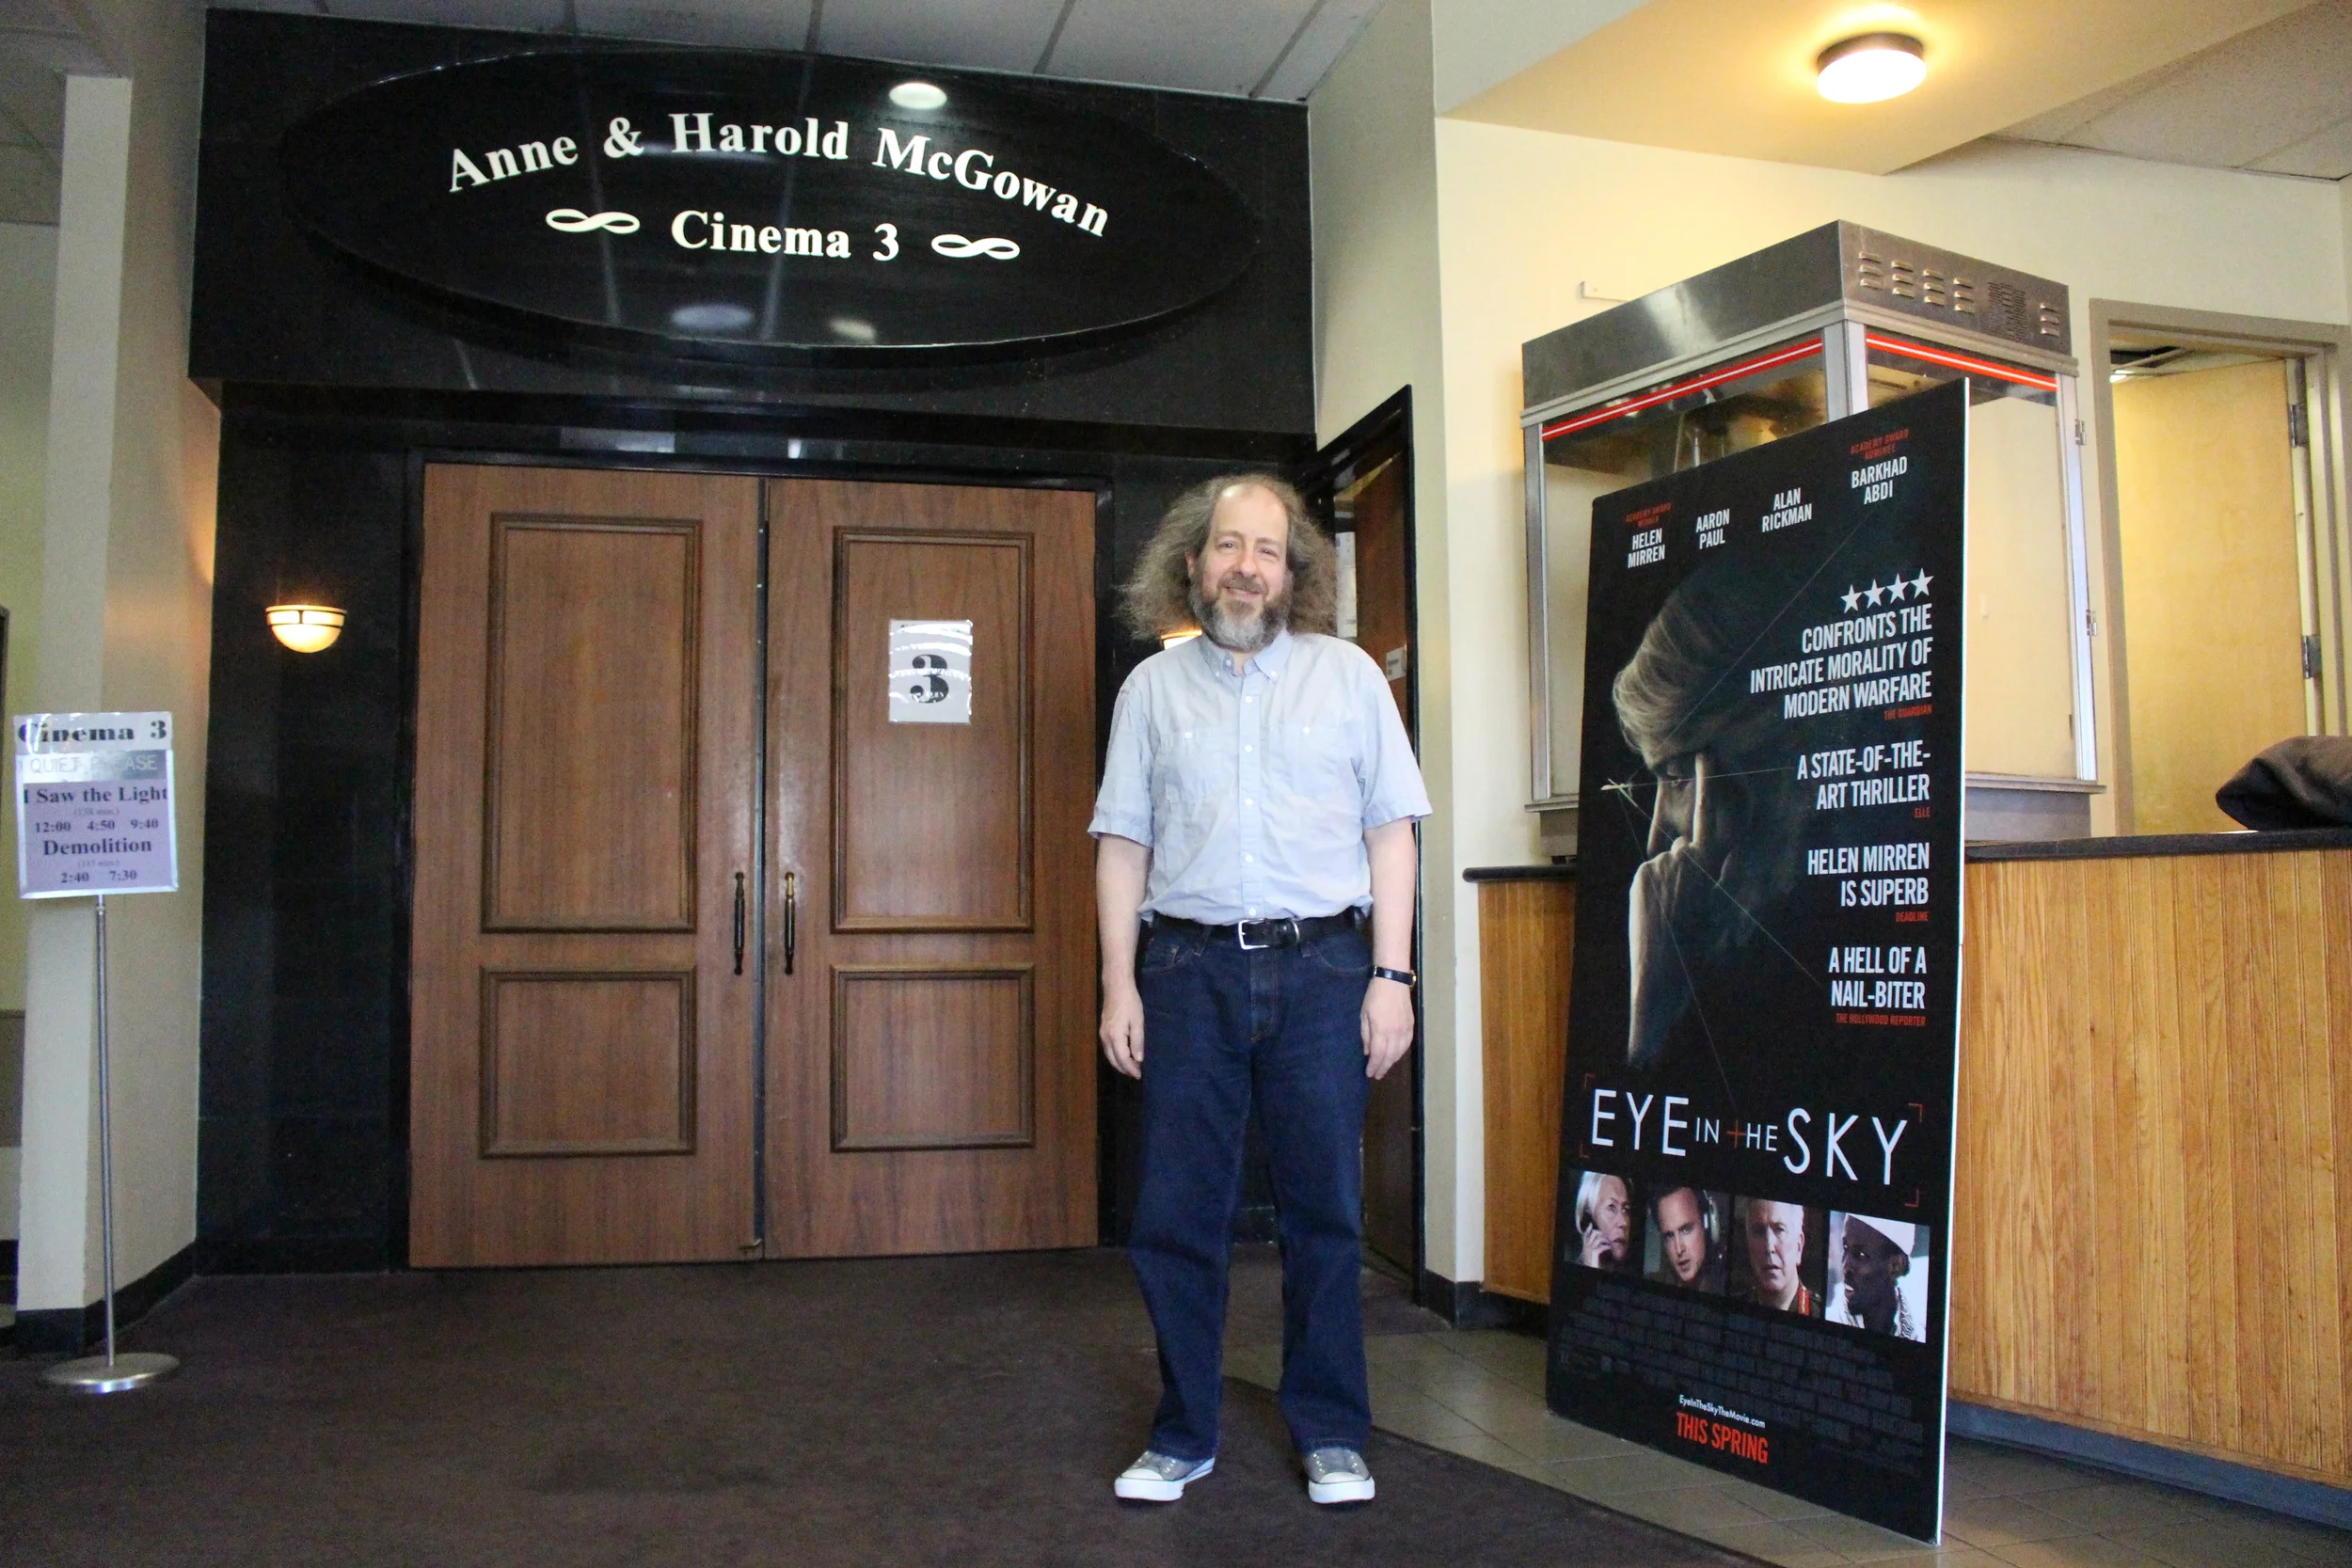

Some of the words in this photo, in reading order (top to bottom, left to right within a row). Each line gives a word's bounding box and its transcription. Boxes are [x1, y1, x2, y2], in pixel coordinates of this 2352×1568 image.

[449, 134, 580, 194] Anne
[602, 117, 645, 159] &
[668, 112, 850, 160] Harold
[875, 128, 1110, 237] McGowan
[672, 209, 851, 259] Cinema
[872, 224, 900, 261] 3
[1851, 455, 1908, 489] BARKHAD
[1772, 487, 1802, 511] ALAN
[1864, 480, 1894, 505] ABDI
[1695, 508, 1730, 533] AARON
[1761, 503, 1813, 532] RICKMAN
[1631, 528, 1662, 551] HELEN
[1699, 529, 1725, 549] PAUL
[1628, 545, 1665, 568] MIRREN
[1802, 610, 1897, 654] CONFRONTS
[1899, 603, 1932, 634] THE
[910, 654, 949, 704] 3
[1750, 657, 1823, 694] INTRICATE
[1827, 641, 1908, 681] MORALITY
[1911, 637, 1933, 666] OF
[1784, 685, 1851, 720] MODERN
[1853, 671, 1932, 708] WARFARE
[18, 722, 135, 742] Cinema
[150, 720, 167, 739] 3
[90, 753, 158, 772] PASE
[1797, 754, 1808, 780] A
[1810, 739, 1931, 779] STATE-OF-THE-
[37, 788, 74, 804] Saw
[83, 787, 112, 802] the
[119, 786, 168, 804] Light
[1816, 783, 1848, 810] ART
[1851, 773, 1931, 806] THRILLER
[35, 820, 72, 833] 12:00
[87, 819, 115, 832] 4:50
[130, 817, 159, 830] 9:40
[43, 837, 152, 856] Demolition
[1807, 847, 1859, 876] HELEN
[1863, 842, 1930, 873] MIRREN
[61, 871, 89, 883] 2:40
[109, 869, 137, 881] 7:30
[1840, 879, 1857, 907] IS
[1860, 877, 1929, 907] SUPERB
[1828, 946, 1839, 974] A
[1844, 946, 1884, 974] HELL
[1888, 946, 1912, 974] OF
[1915, 946, 1927, 974] A
[1831, 980, 1925, 1009] NAIL-BITER
[1591, 1088, 1690, 1157] EYE
[1695, 1117, 1720, 1145] IN
[1783, 1107, 1908, 1185] SKY
[1678, 1393, 1766, 1429] EyeInTheSkyTheMovie.com
[1677, 1411, 1708, 1445] THIS
[1710, 1422, 1769, 1465] SPRING
